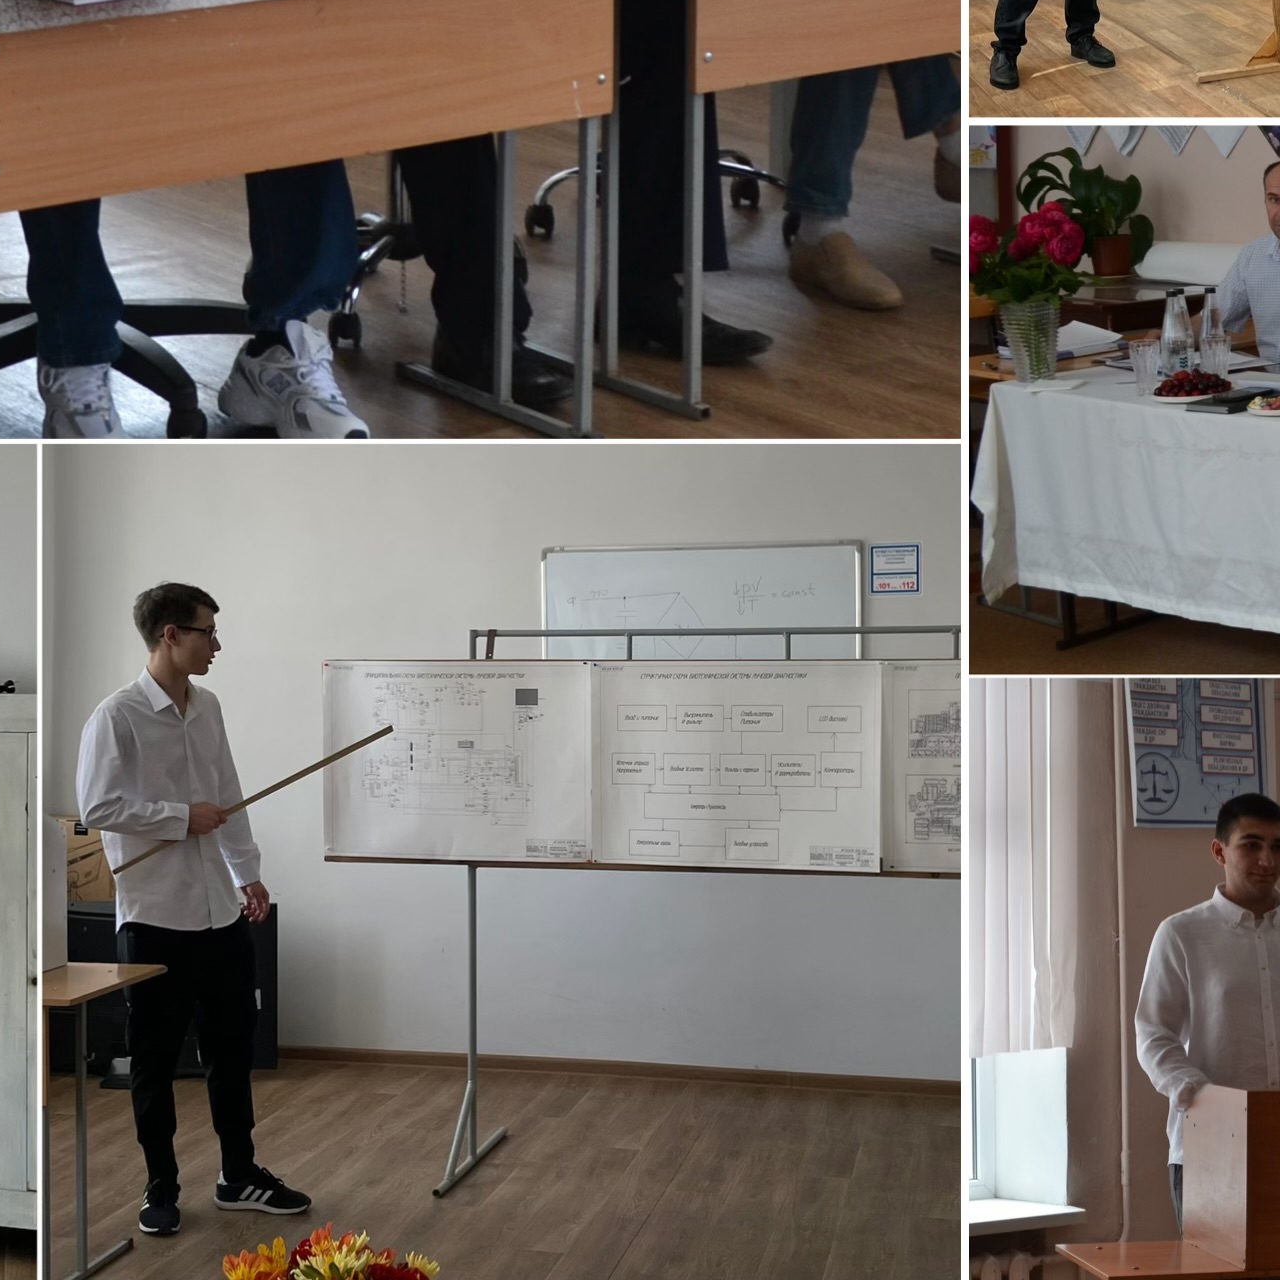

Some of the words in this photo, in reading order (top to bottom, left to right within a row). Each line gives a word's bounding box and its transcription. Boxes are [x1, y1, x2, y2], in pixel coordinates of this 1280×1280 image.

[781, 582, 817, 598] const
[878, 582, 891, 590] 101
[901, 581, 916, 589] 112
